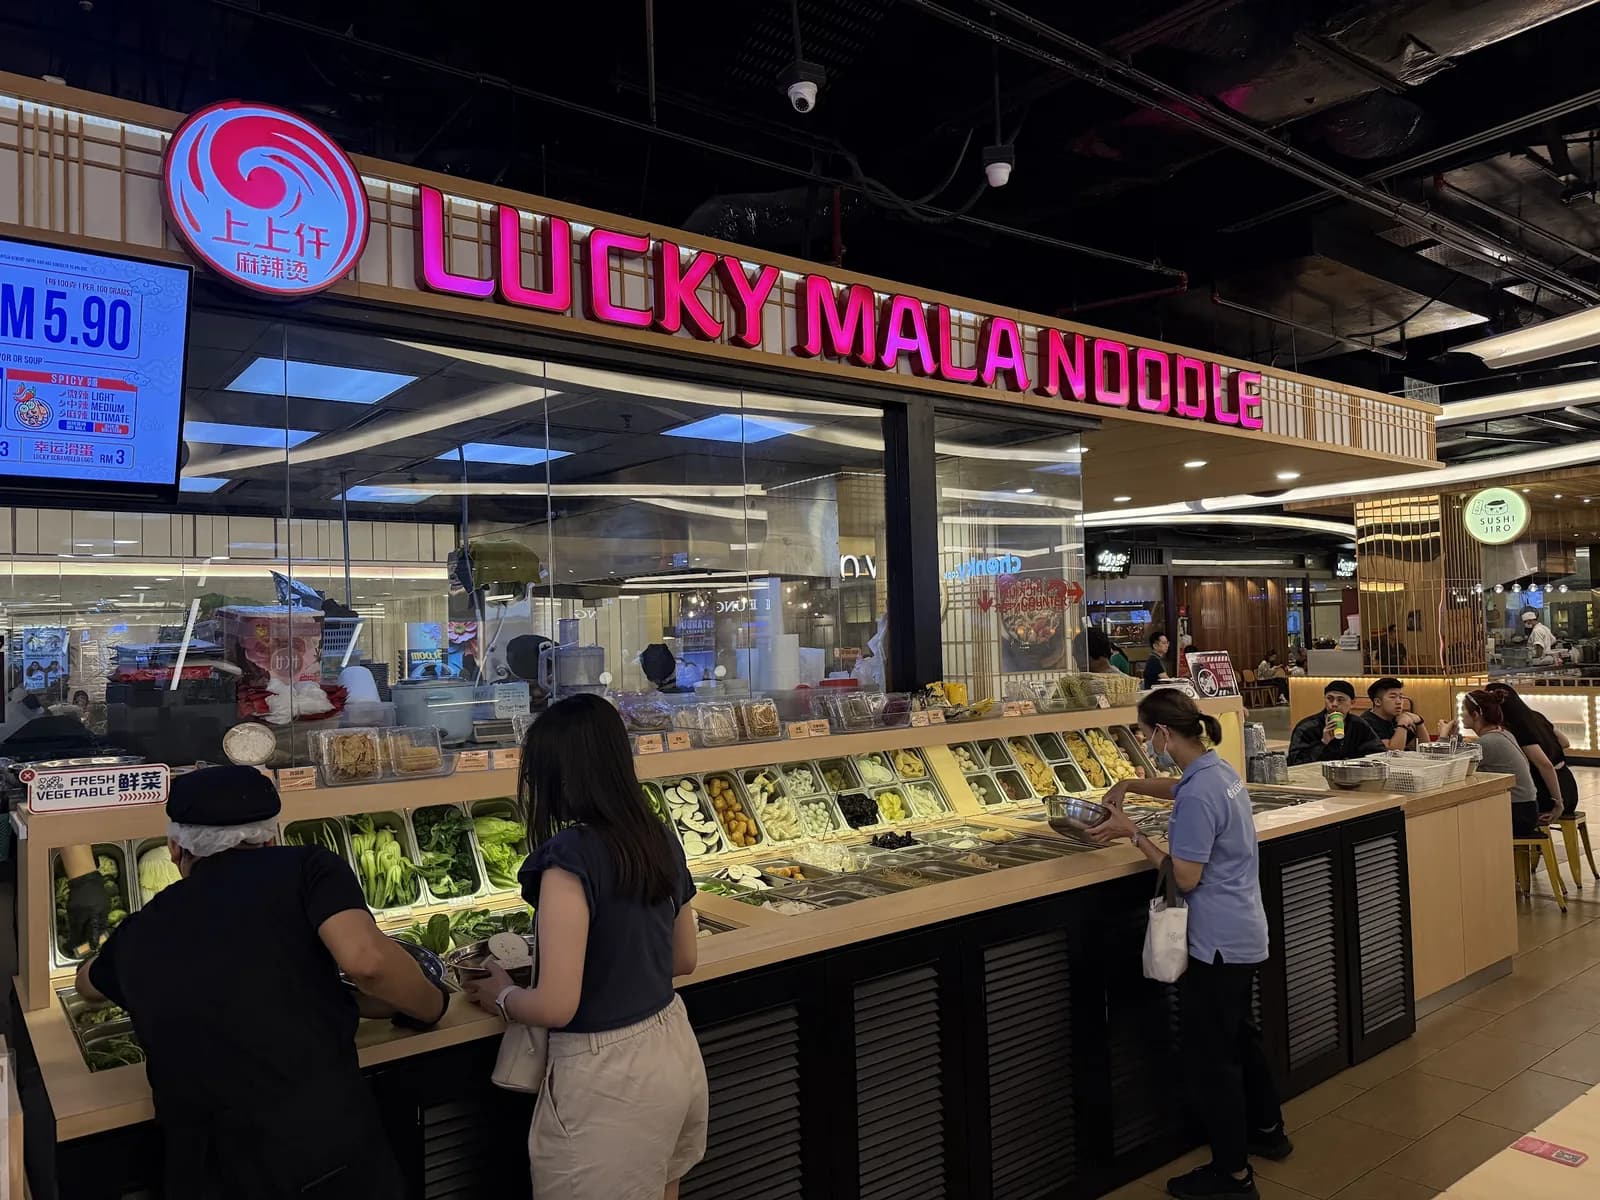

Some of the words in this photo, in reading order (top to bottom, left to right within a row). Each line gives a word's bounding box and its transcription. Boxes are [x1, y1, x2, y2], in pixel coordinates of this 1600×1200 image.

[236, 251, 309, 283] 麻辣烫
[416, 182, 784, 348] LUCKY
[800, 273, 1030, 393] MALA
[1036, 327, 1264, 430] NOODLE
[44, 289, 131, 351] 5.90
[13, 354, 22, 363] OR
[24, 355, 43, 365] SOUP
[51, 374, 84, 386] SPICY
[91, 391, 115, 402] LIGHT
[91, 401, 125, 413] MEDIUM
[91, 412, 130, 424] ULTIMATE
[0, 440, 9, 456] 3
[34, 440, 94, 457] 幸运滑蛋
[100, 454, 113, 464] RM
[116, 449, 125, 464] 3
[1480, 515, 1515, 525] SUSHI
[1485, 524, 1511, 533] JIRO
[71, 774, 115, 786] FRESH
[118, 770, 162, 792] 鲜菜
[37, 786, 115, 800] VEGETABLE
